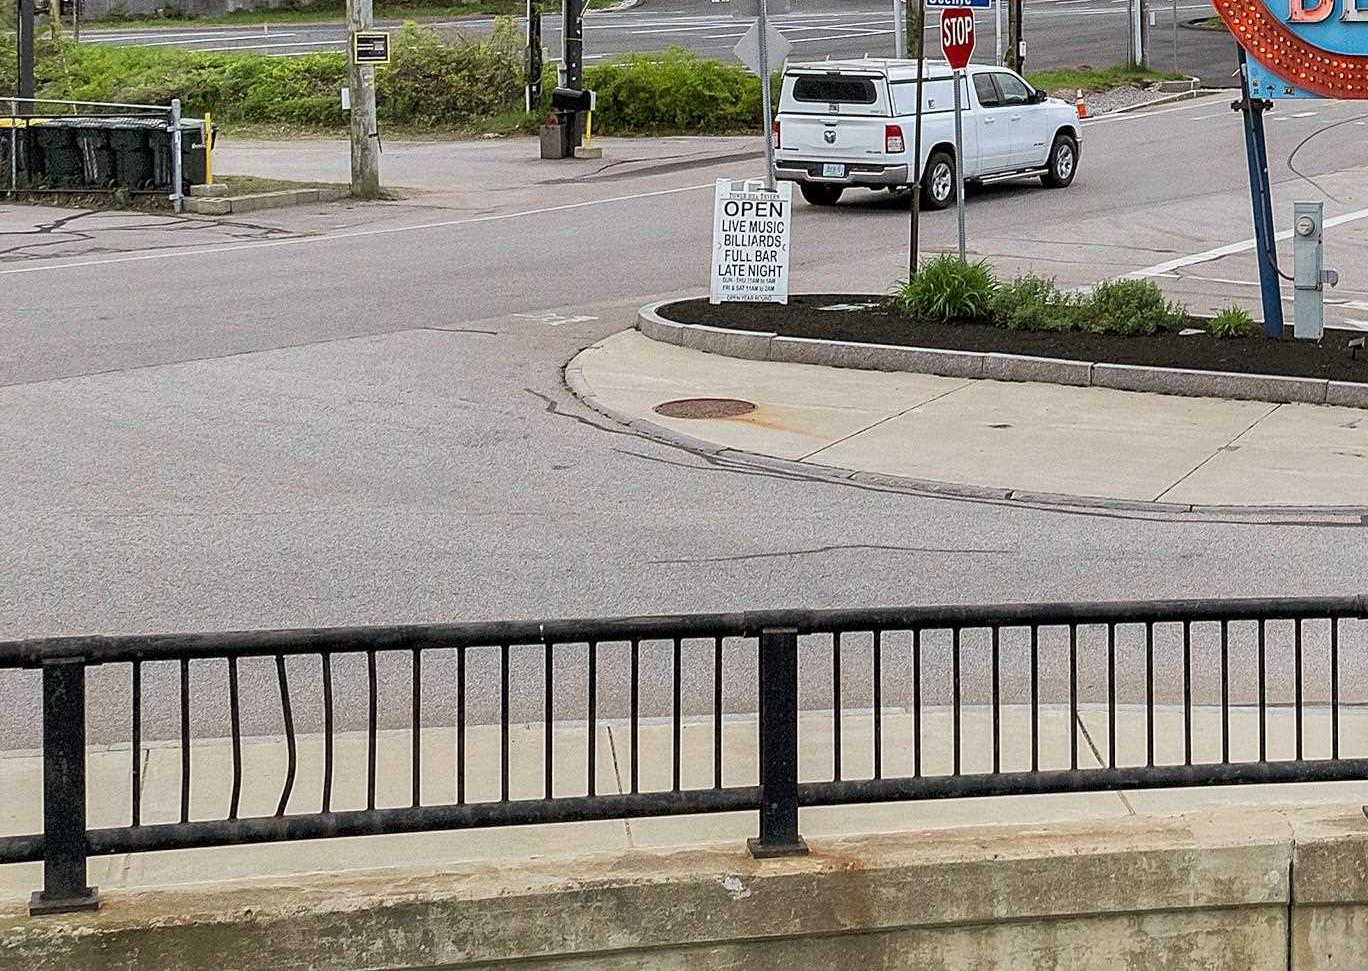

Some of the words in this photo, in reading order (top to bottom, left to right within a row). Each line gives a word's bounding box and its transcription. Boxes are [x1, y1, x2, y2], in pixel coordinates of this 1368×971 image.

[943, 16, 973, 47] STOP
[724, 201, 783, 218] OPEN
[722, 219, 746, 233] LIVE
[749, 220, 785, 234] MUSIC
[724, 234, 782, 248] BILLIARDS
[724, 249, 752, 262] FULL
[755, 250, 778, 263] BAR
[718, 264, 745, 277] LATE
[748, 265, 783, 278] NIGHT
